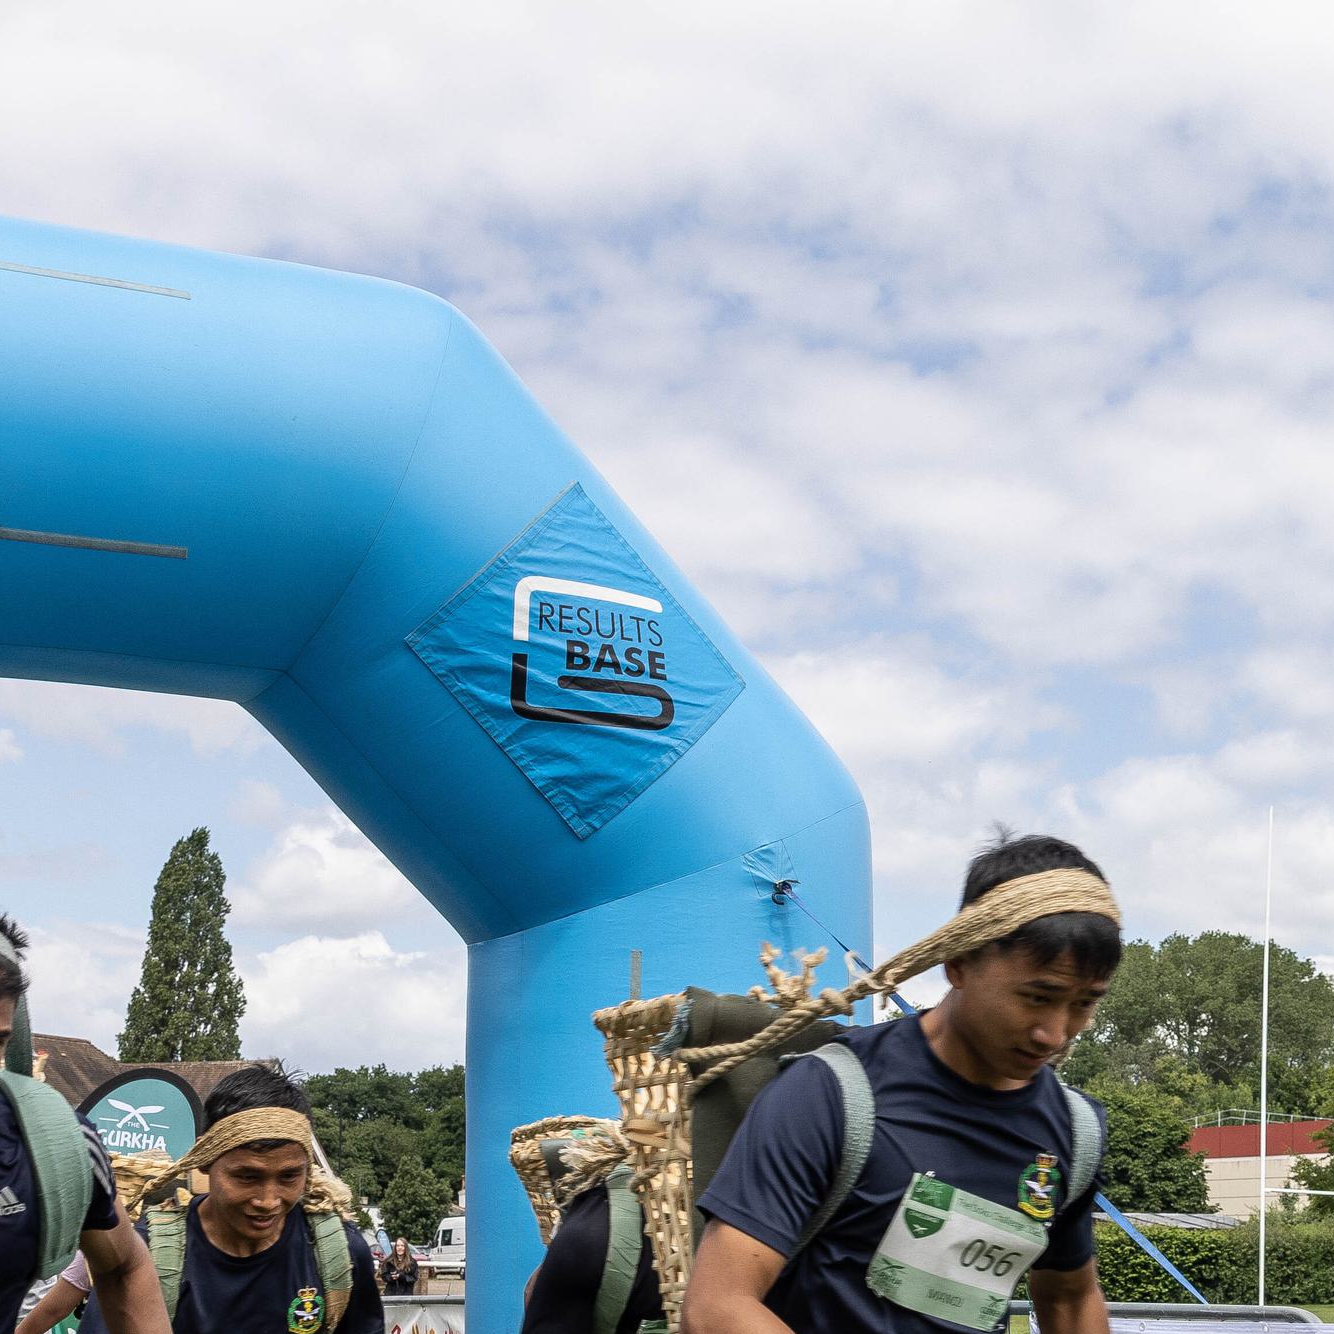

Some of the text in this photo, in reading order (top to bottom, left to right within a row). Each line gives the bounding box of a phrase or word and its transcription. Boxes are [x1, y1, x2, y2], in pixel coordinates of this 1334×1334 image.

[538, 601, 664, 647] RESULTS
[566, 639, 667, 681] BASE
[960, 1238, 1023, 1277] 056
